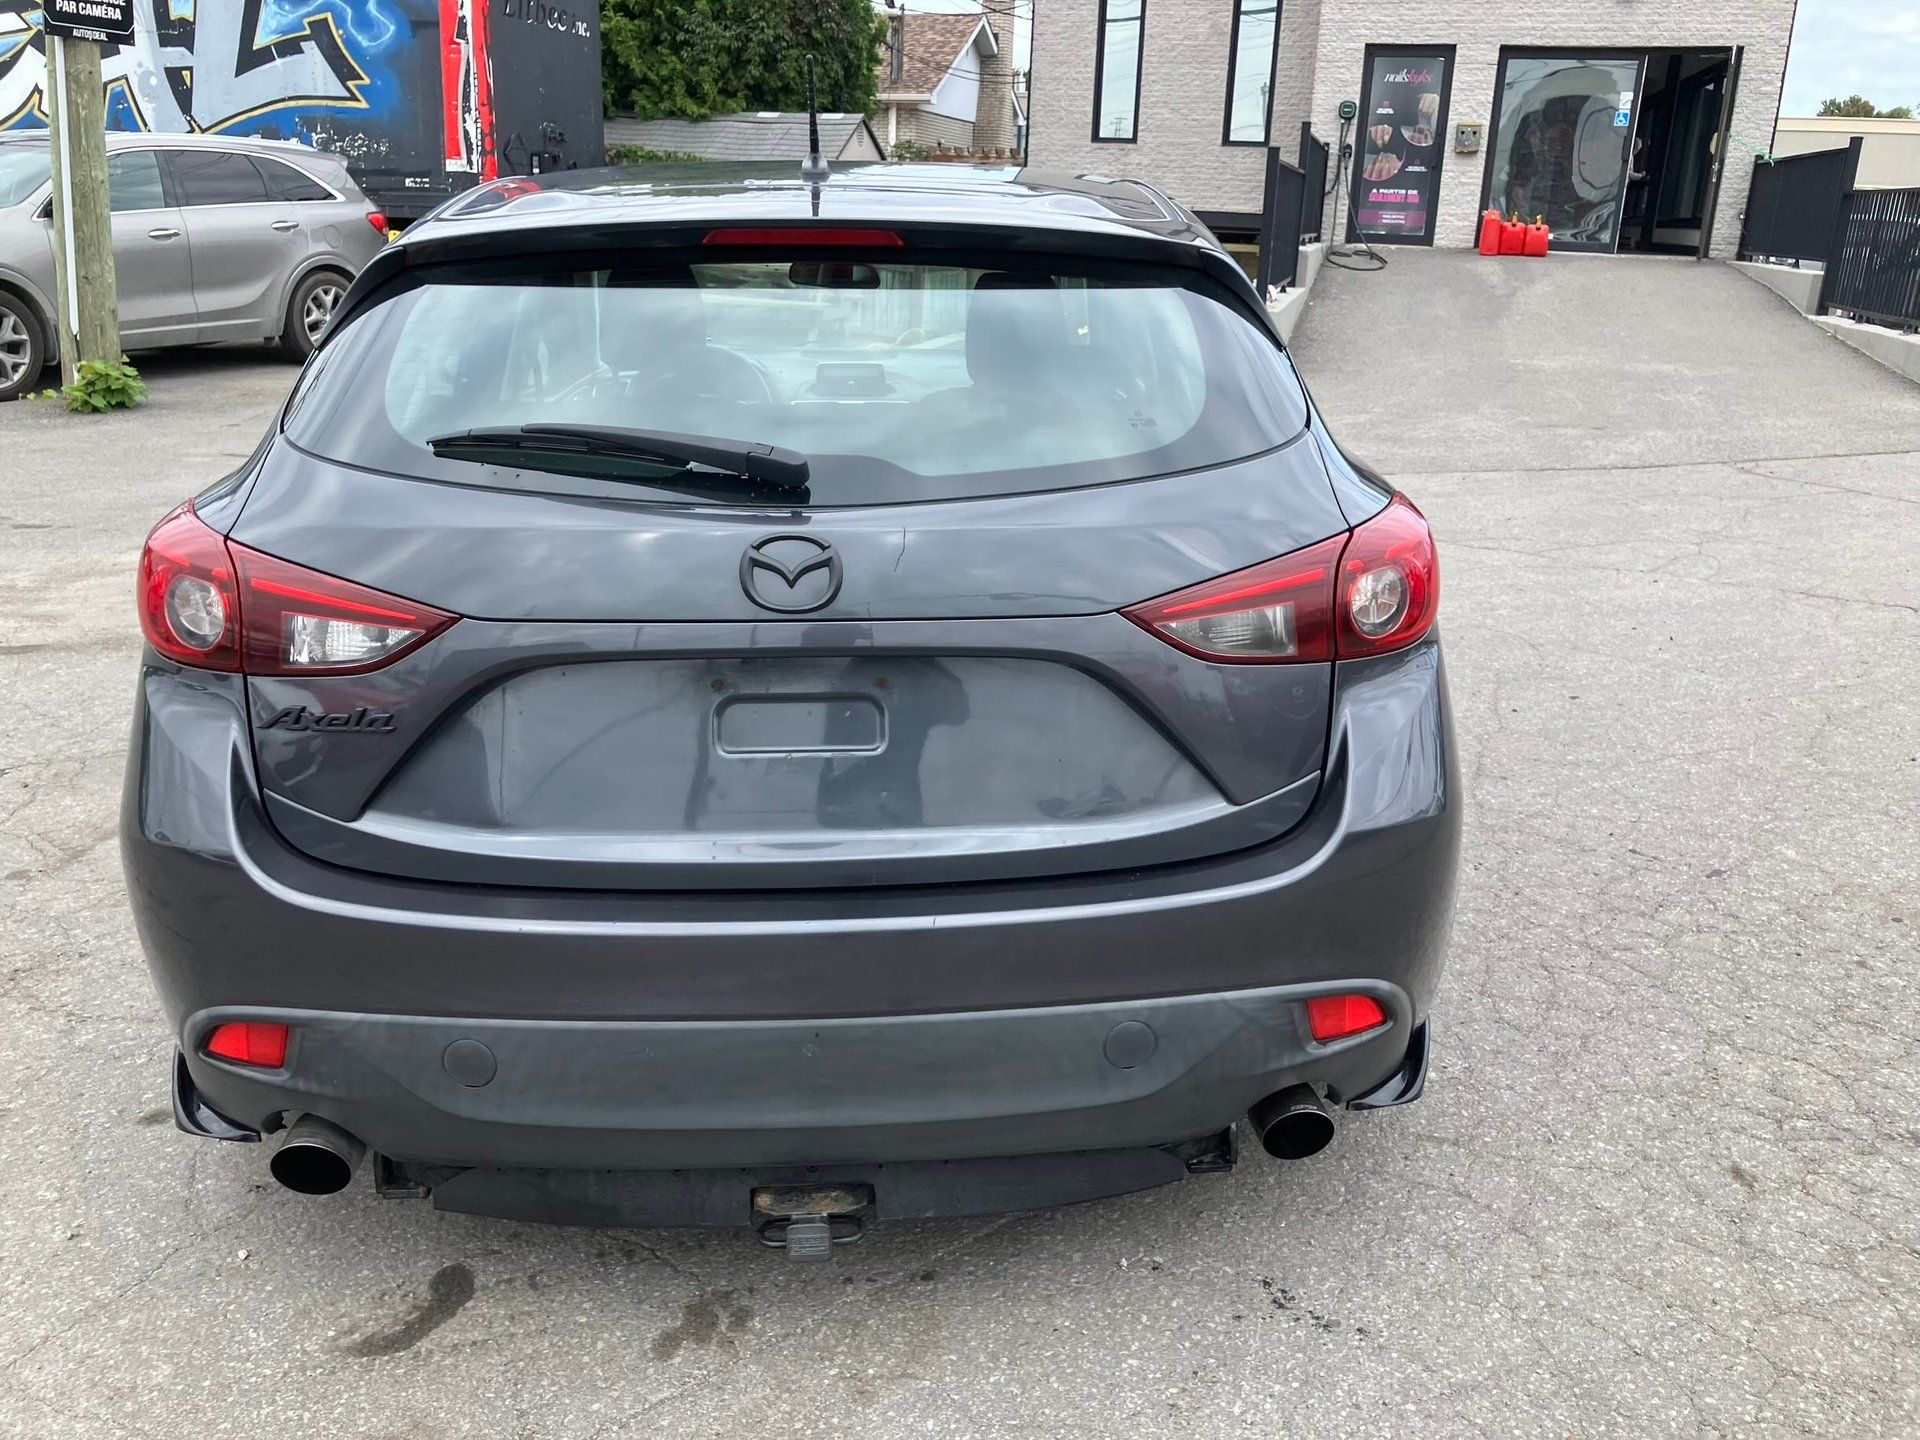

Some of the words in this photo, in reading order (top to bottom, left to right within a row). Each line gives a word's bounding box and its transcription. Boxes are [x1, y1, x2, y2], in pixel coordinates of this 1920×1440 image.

[55, 0, 77, 14] PAR
[78, 2, 122, 21] CAMÉRA
[256, 704, 397, 733] Axela
